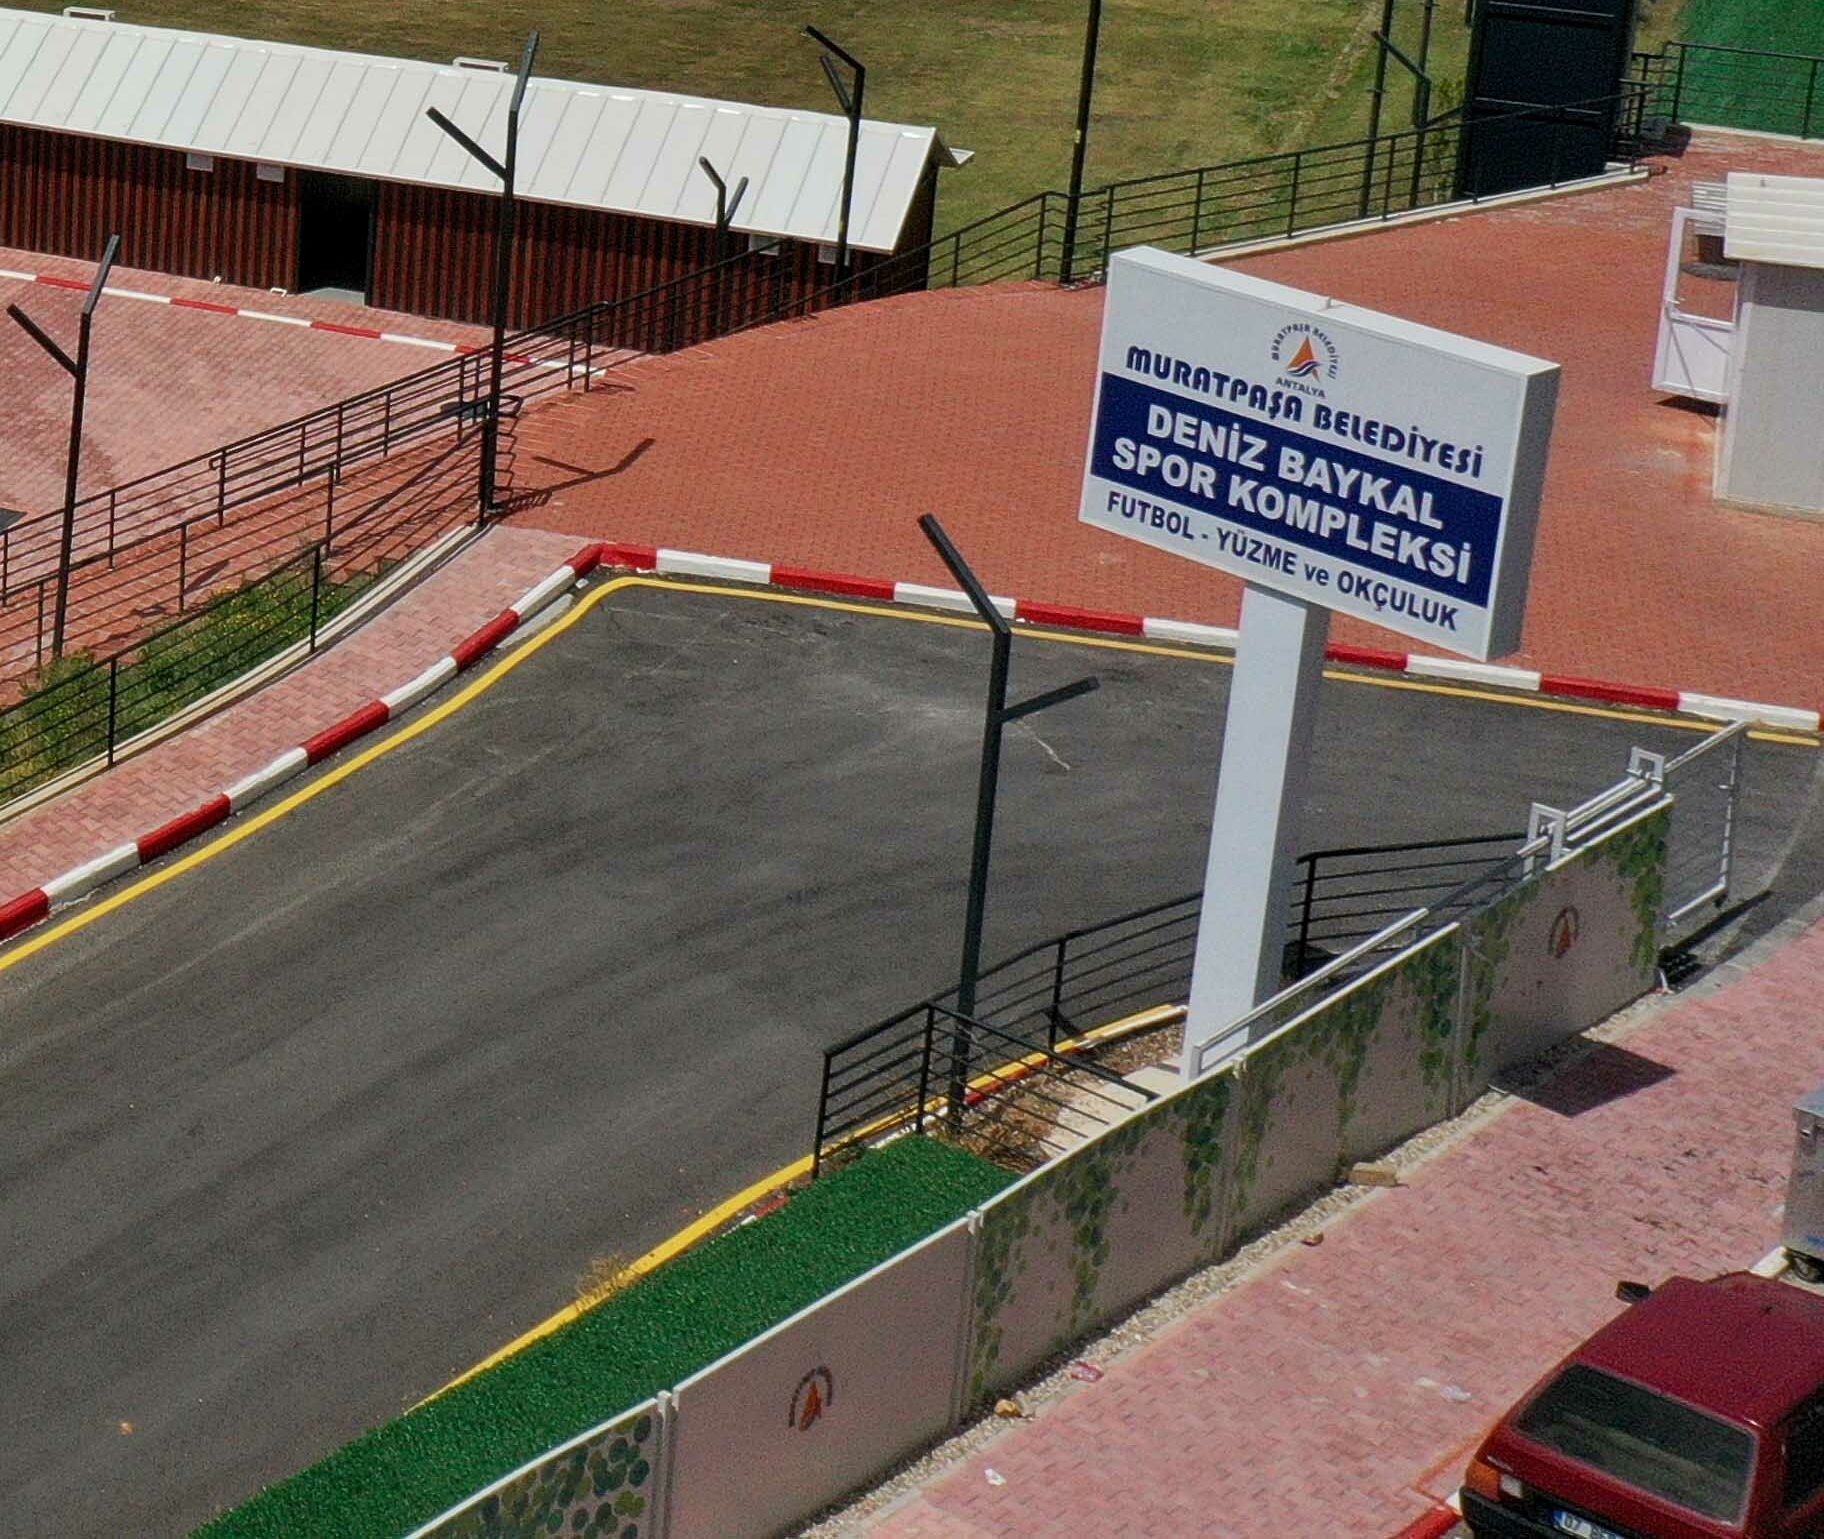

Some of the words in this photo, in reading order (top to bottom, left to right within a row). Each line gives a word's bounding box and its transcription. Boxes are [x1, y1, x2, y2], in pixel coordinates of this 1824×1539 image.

[1126, 345, 1303, 421] MURATPAŞA
[1313, 404, 1484, 479] BELEDİYESİ
[1275, 376, 1327, 399] ANTALYA
[1112, 437, 1217, 500] SPOR
[1227, 473, 1473, 585] KOMPLEKSİ
[1146, 402, 1268, 472] DENİZ
[1278, 446, 1444, 530] BAYKAL
[1107, 491, 1195, 540] FUTBOL
[1216, 526, 1298, 575] YÜZME
[1303, 563, 1330, 587] ve
[1336, 570, 1458, 631] OKÇULUK
